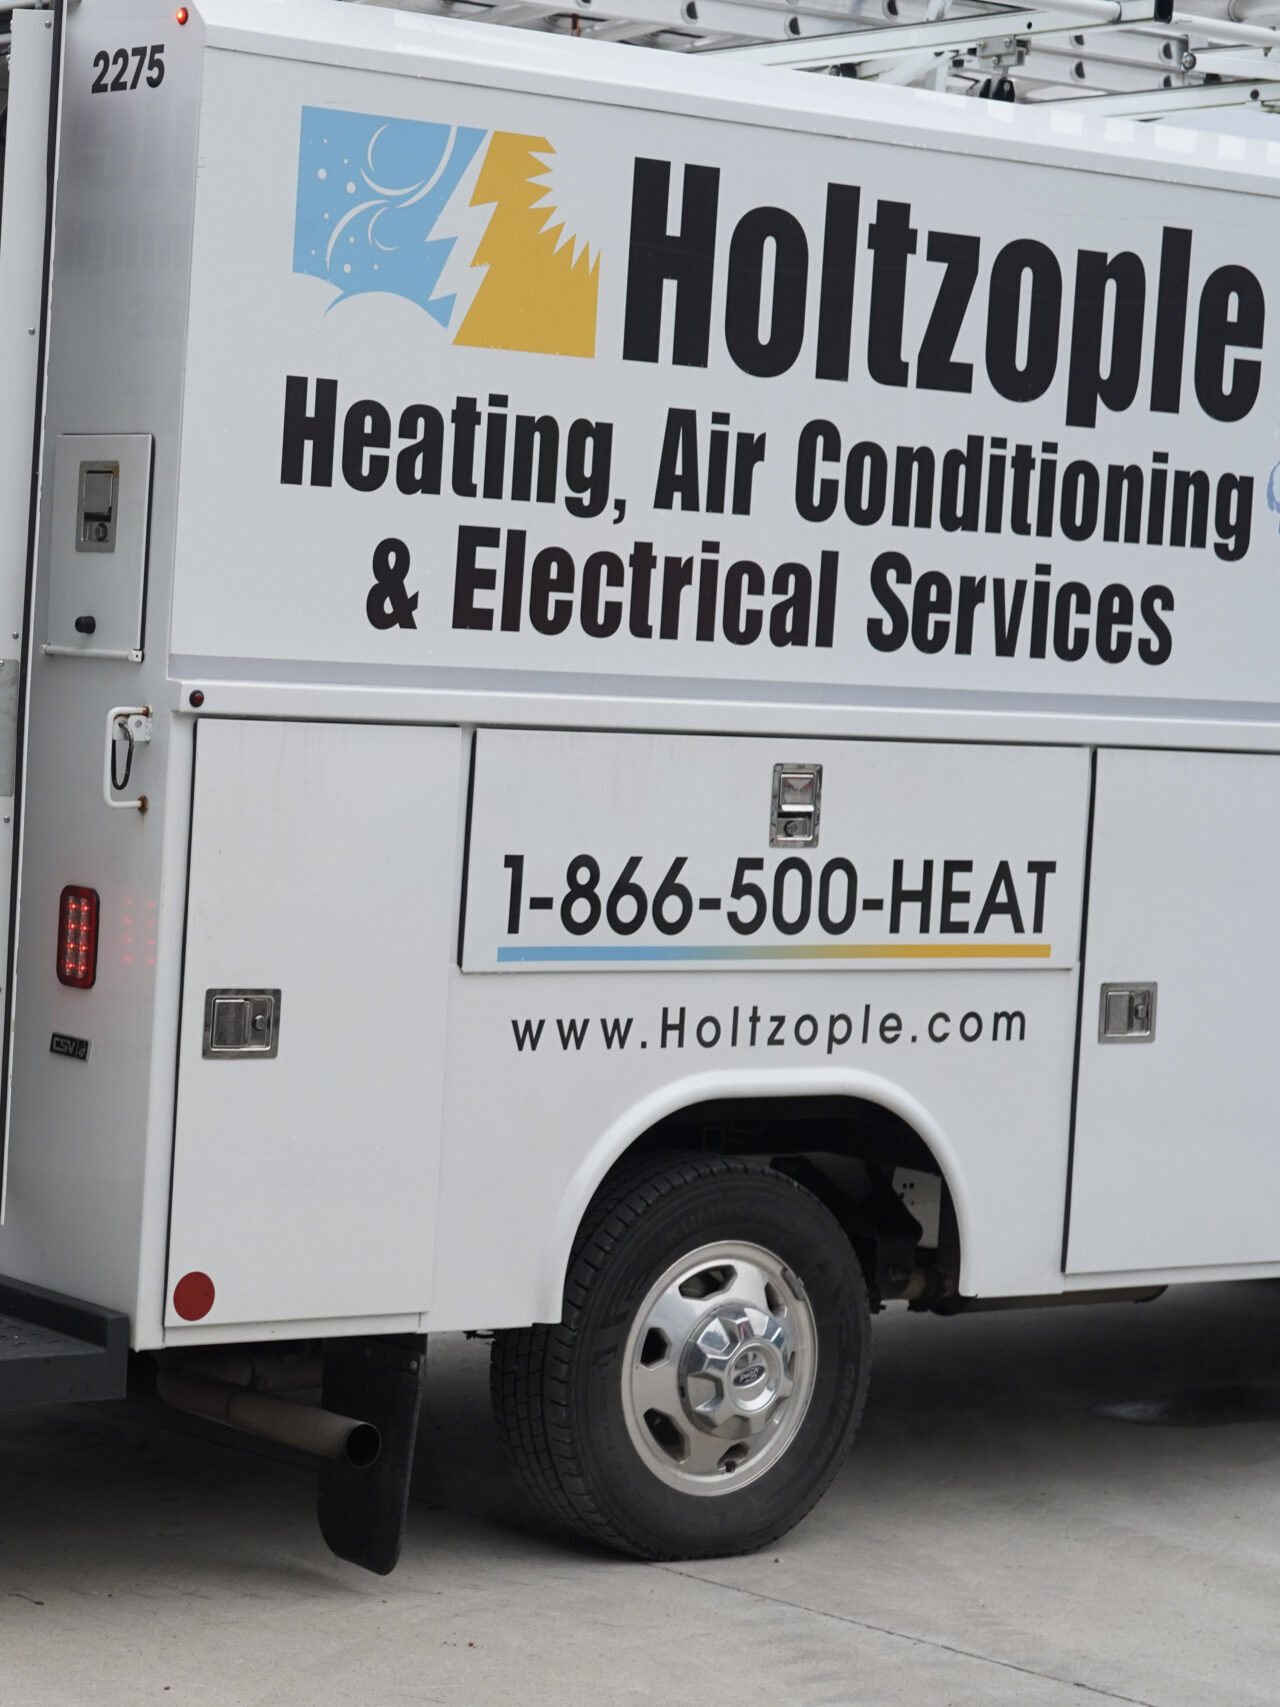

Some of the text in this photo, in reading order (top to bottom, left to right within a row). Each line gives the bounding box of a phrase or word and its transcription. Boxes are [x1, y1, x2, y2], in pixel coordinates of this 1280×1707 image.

[91, 44, 165, 94] 2275
[622, 156, 1266, 429] Holtzople
[281, 376, 1255, 562] Heating, Air Conditioning
[365, 525, 1175, 666] & Electrical Services
[503, 854, 1057, 936] 1-866-500-HEAT
[511, 1004, 1026, 1055] www.Holtzople.com
